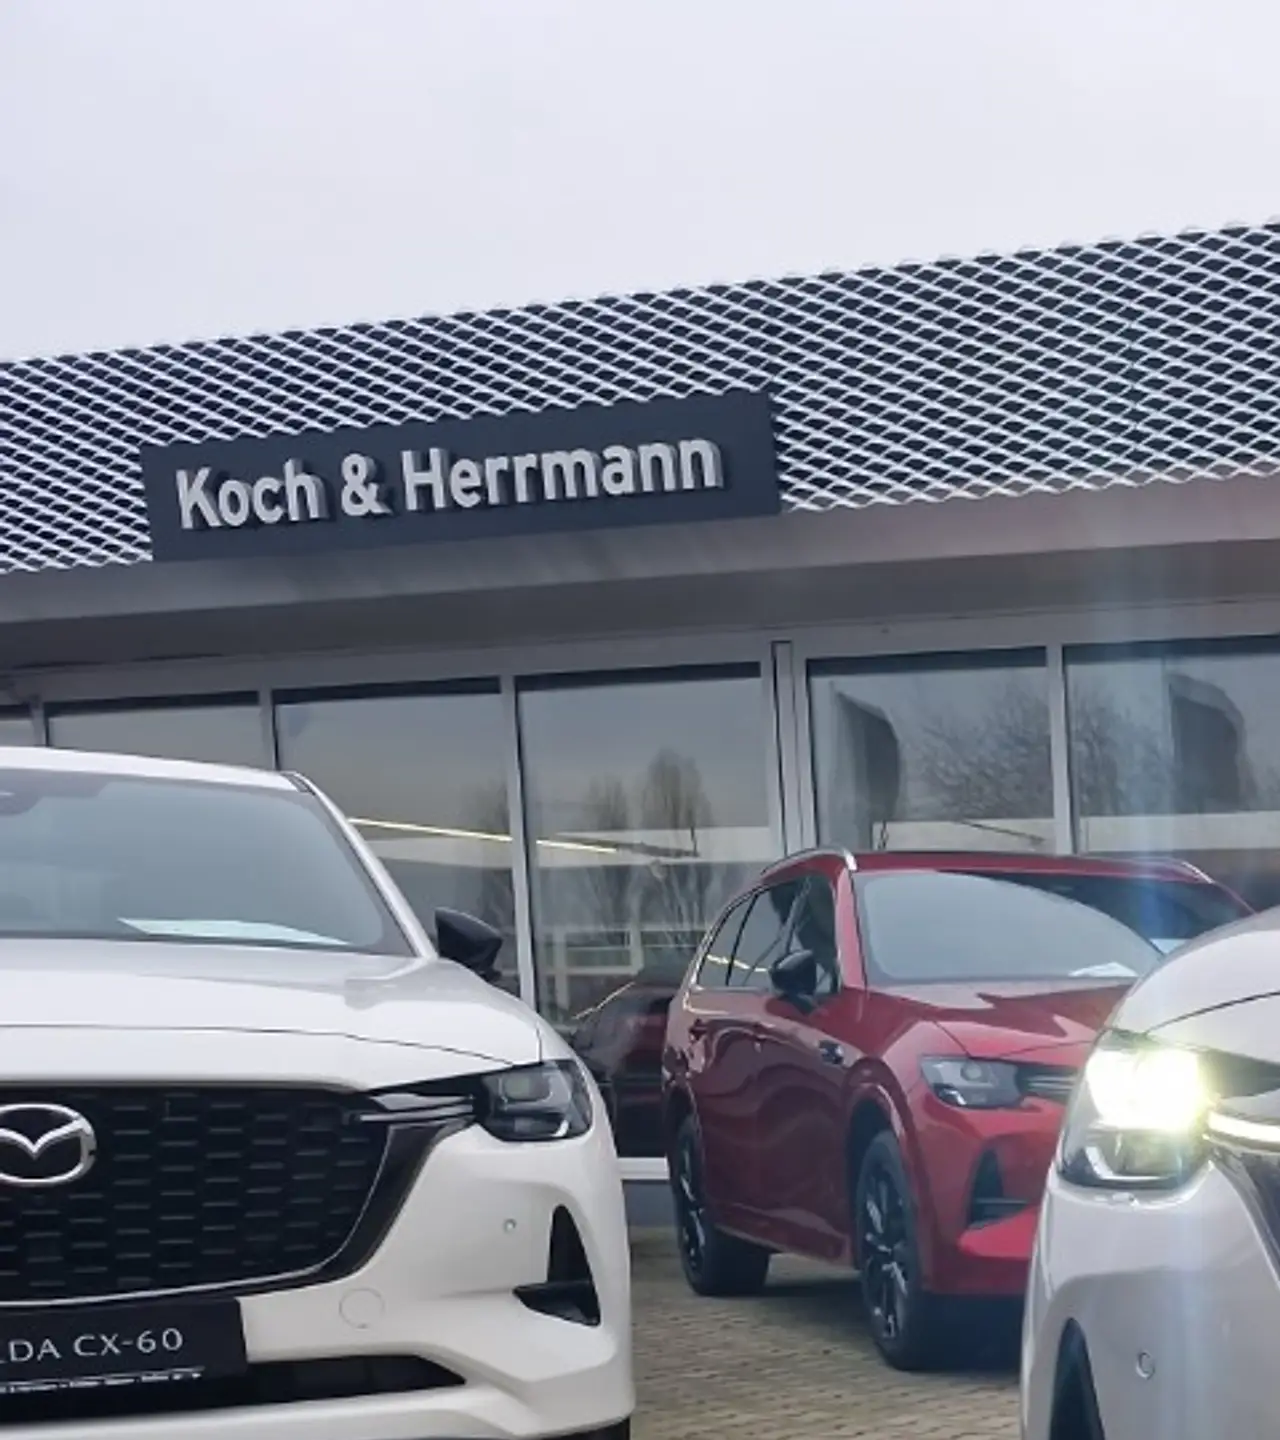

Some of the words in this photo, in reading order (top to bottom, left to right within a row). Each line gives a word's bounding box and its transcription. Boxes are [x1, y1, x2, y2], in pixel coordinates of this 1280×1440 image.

[175, 458, 324, 530] Koch
[340, 452, 393, 517] &
[401, 437, 722, 512] Herrmann
[73, 1328, 183, 1357] CX-60
